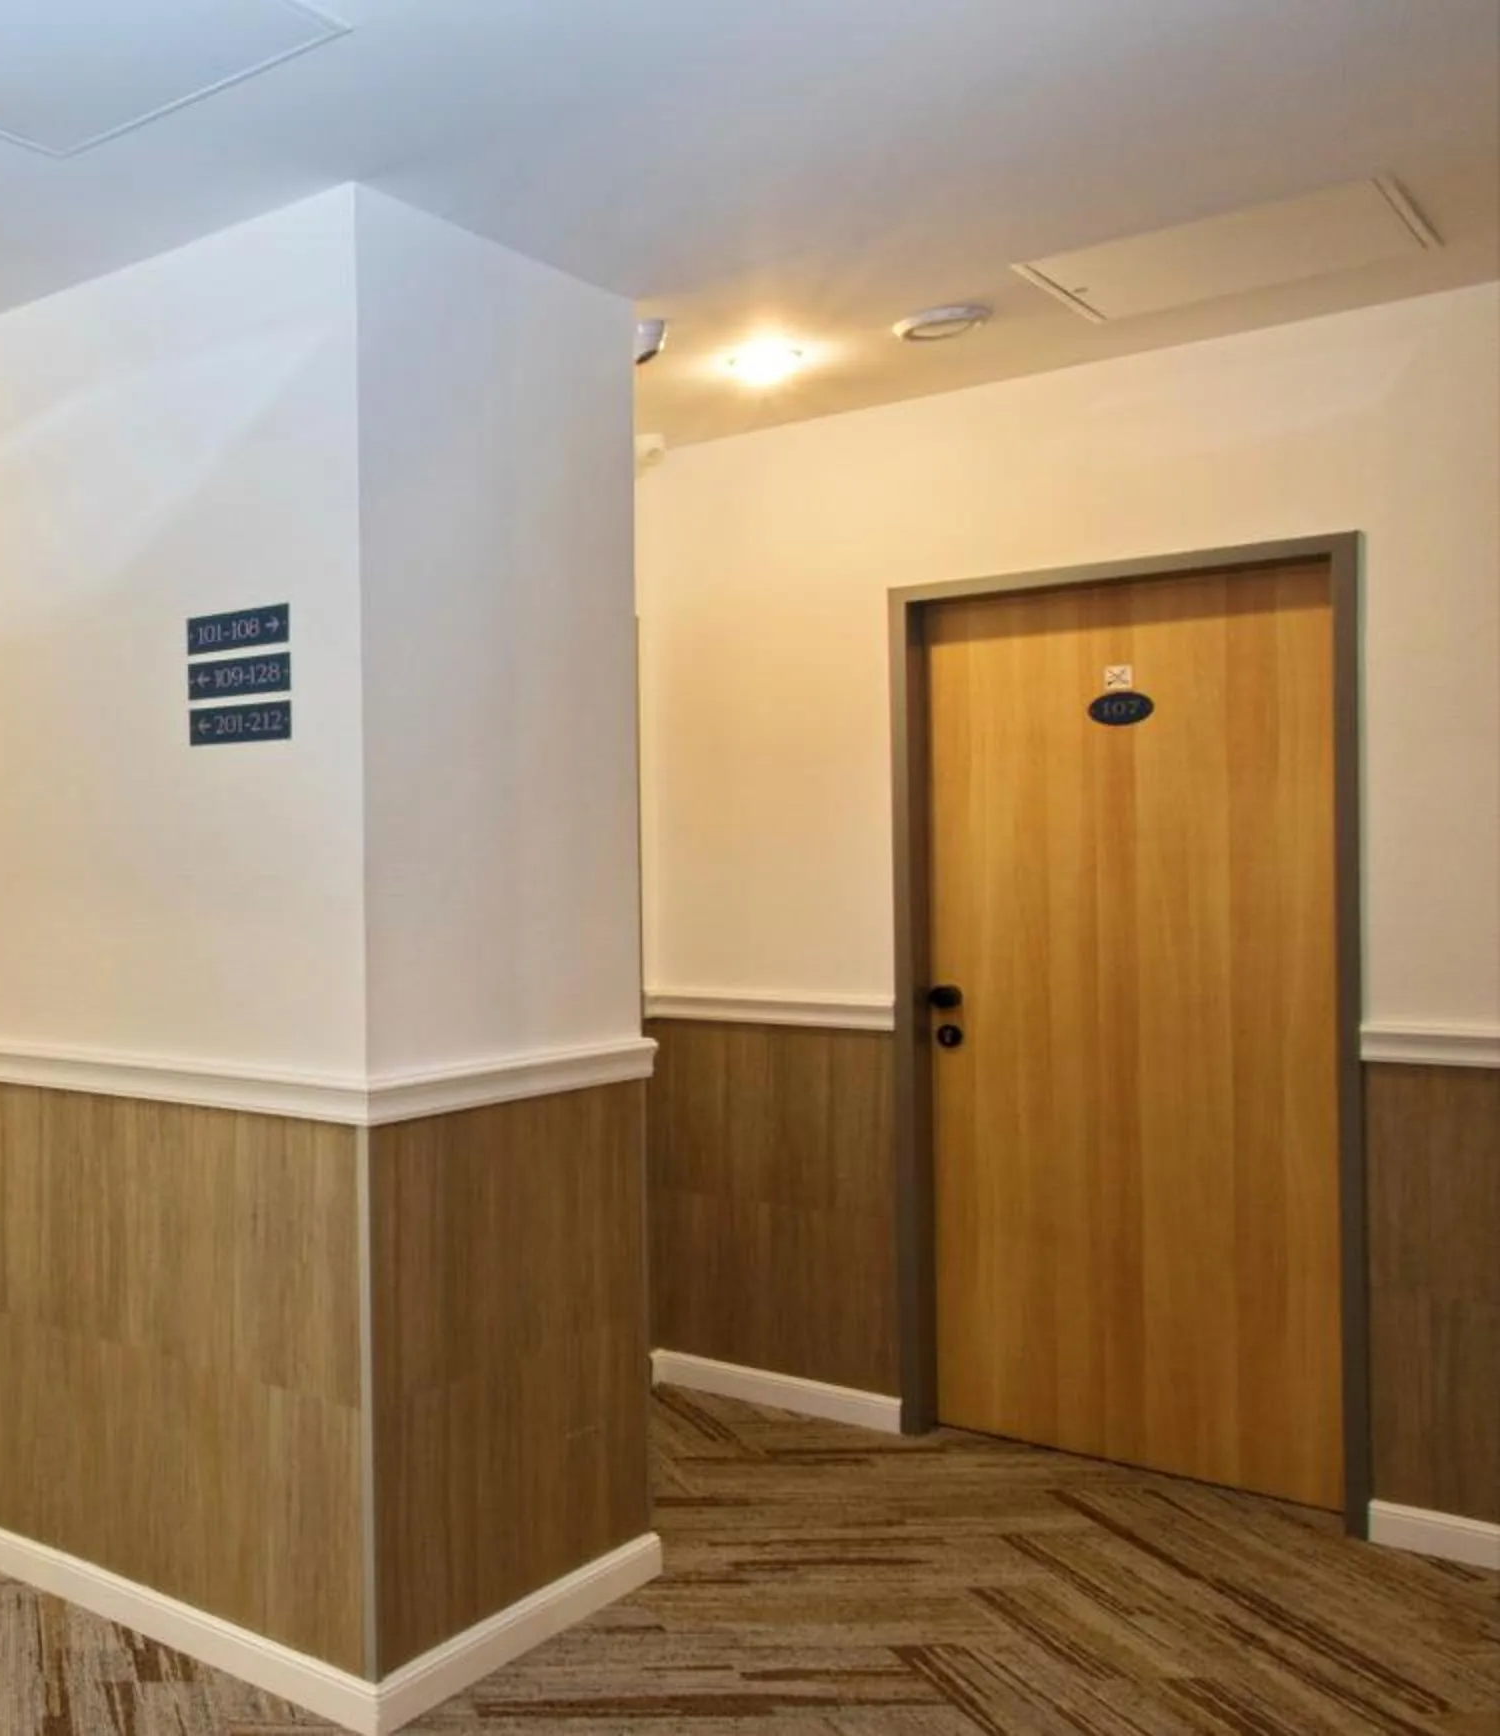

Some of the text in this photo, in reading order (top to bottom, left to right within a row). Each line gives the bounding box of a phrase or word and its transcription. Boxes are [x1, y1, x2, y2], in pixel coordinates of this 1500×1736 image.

[197, 618, 260, 645] 101-108
[214, 661, 281, 688] 109-128
[1103, 700, 1141, 717] 107
[214, 710, 283, 735] 201-212
